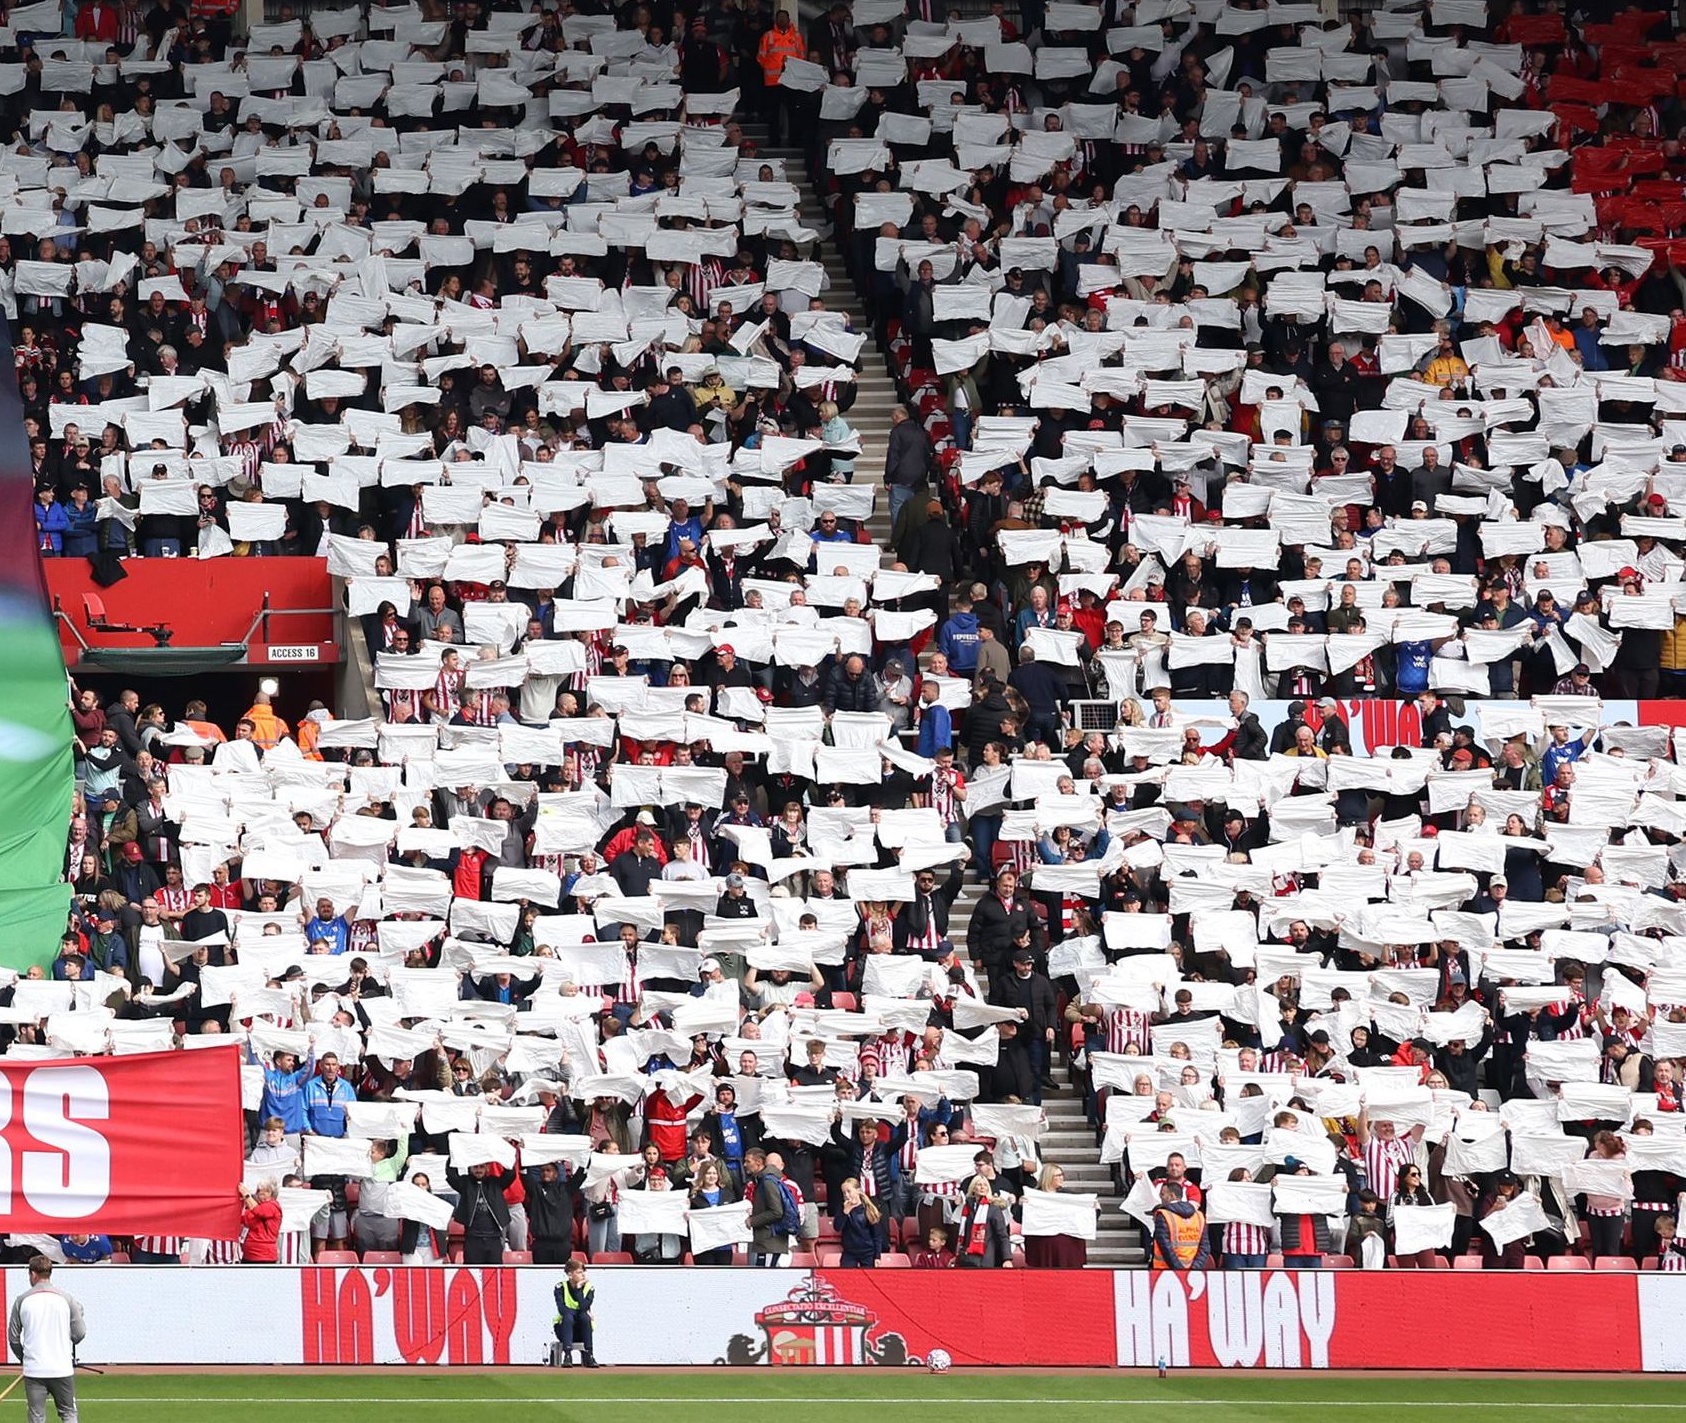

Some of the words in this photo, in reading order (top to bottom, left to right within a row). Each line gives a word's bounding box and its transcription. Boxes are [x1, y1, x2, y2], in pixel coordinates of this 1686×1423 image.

[271, 647, 303, 658] ACCESS
[305, 647, 316, 658] 16
[302, 1267, 518, 1366] HA'WAY
[1114, 1270, 1337, 1369] HA'WAY
